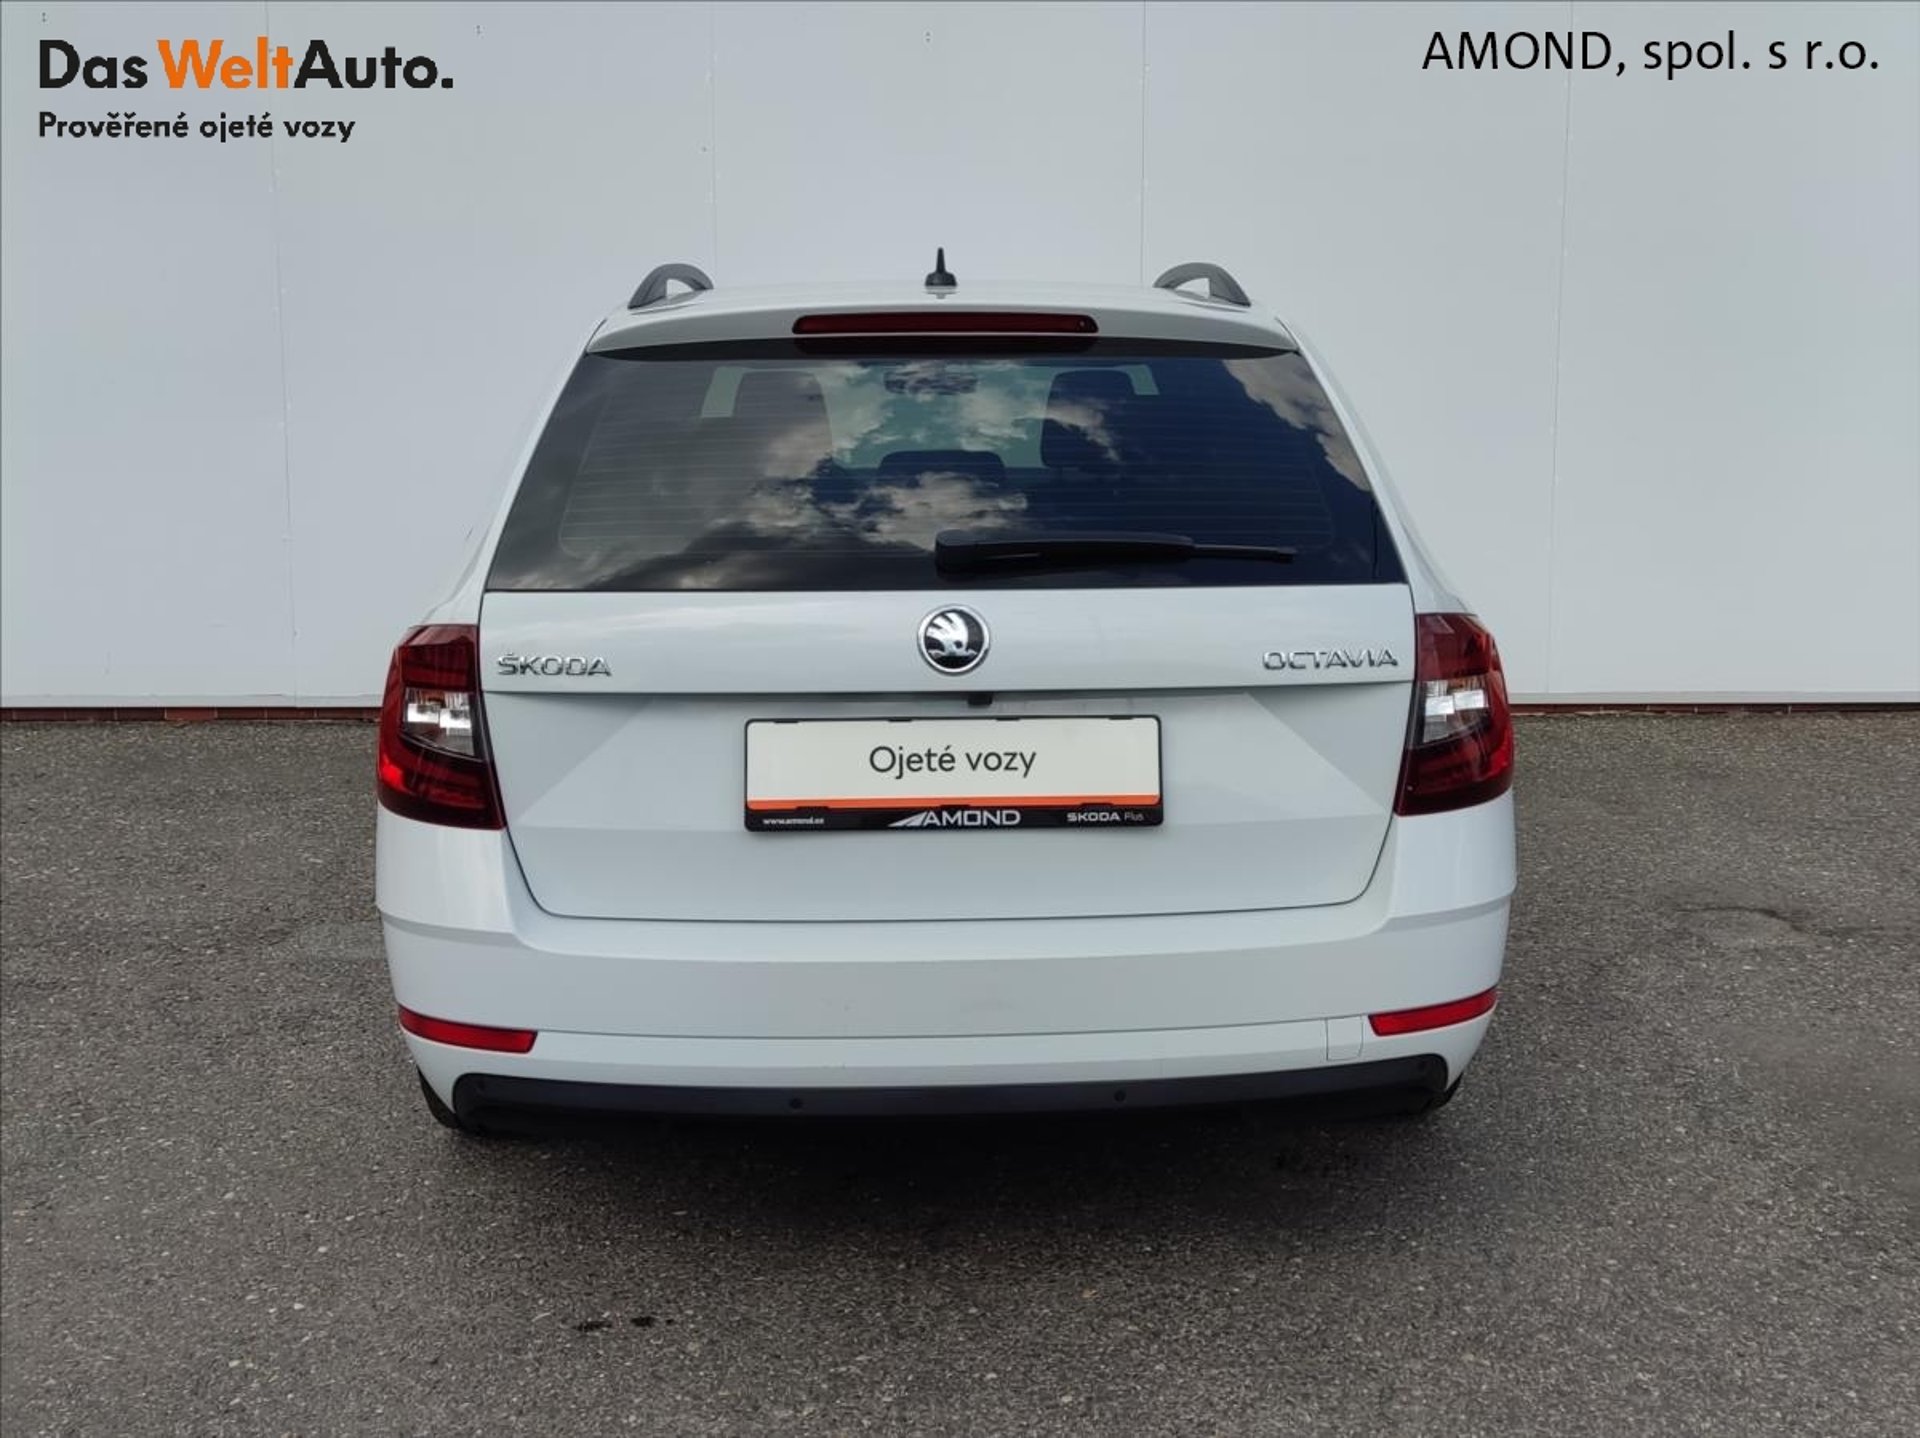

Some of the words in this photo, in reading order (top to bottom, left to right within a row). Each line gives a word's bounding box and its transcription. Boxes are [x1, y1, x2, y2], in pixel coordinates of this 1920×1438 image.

[498, 653, 612, 677] ŠKODA
[1263, 648, 1399, 670] OCTAVIA
[869, 745, 956, 780] Ojeté
[966, 750, 1037, 778] vozy
[921, 809, 1021, 827] AMOND
[1124, 811, 1145, 822] Plus
